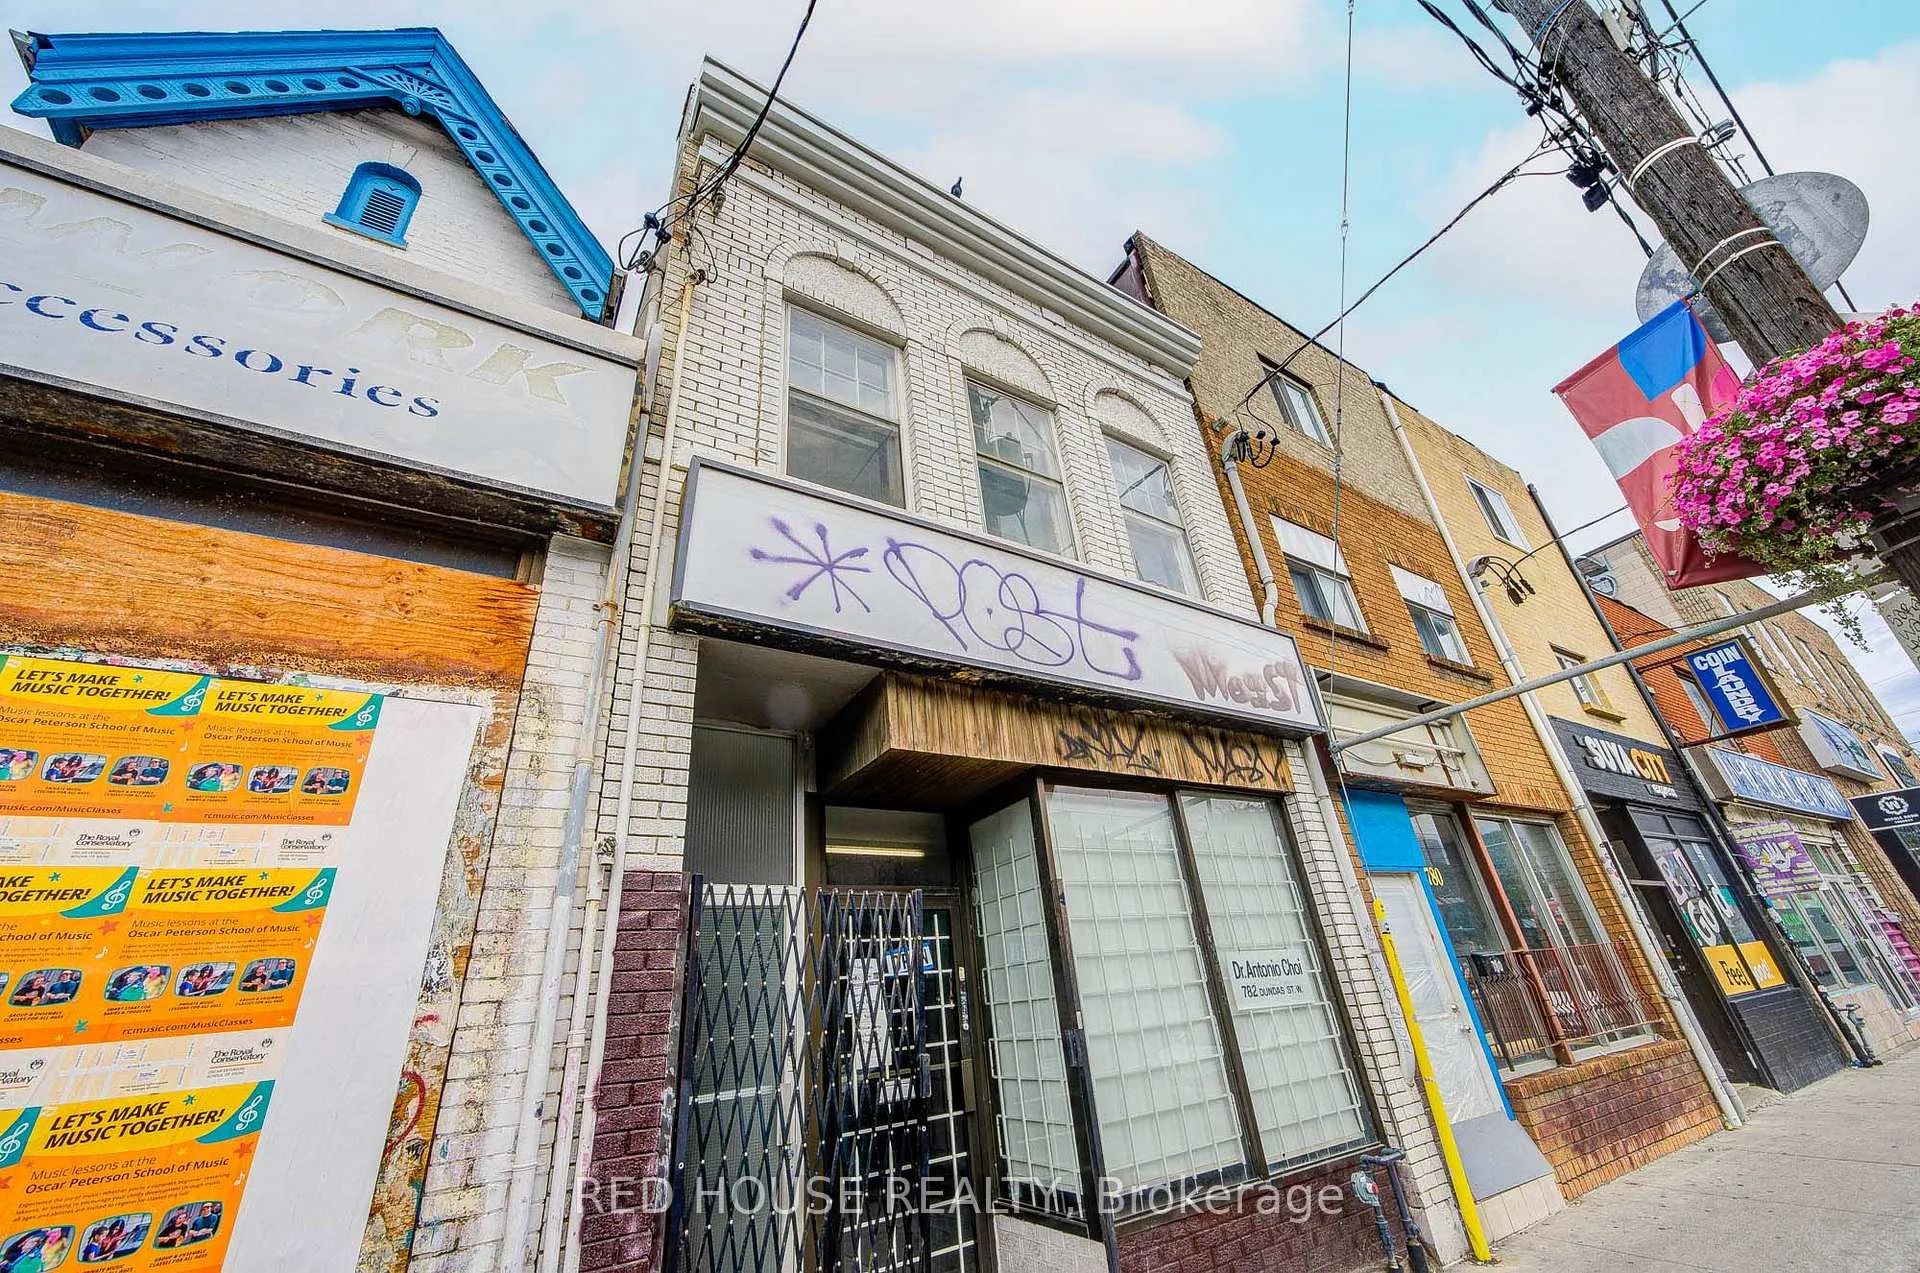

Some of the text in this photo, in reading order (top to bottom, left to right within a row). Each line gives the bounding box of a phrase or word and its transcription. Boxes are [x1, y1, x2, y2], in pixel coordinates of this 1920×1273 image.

[1693, 645, 1744, 671] COIN
[16, 669, 121, 686] LET'S MAKE
[10, 682, 172, 701] MUSIC TOGETHER!
[217, 691, 304, 704] LET'S MAKE
[0, 706, 32, 716] Music
[35, 709, 77, 720] lessons
[215, 702, 347, 718] MUSIC TOGETHER!
[33, 717, 88, 730] Peterson
[90, 721, 129, 733] School
[130, 724, 142, 733] of
[143, 726, 177, 736] Music
[206, 724, 235, 733] Music
[204, 732, 353, 748] Oscar Peterson School of Music
[75, 839, 133, 848] Conservatory
[79, 834, 121, 843] The Royal
[148, 875, 247, 890] LET'S MAKE
[1424, 866, 1444, 887] 780
[142, 886, 296, 904] MUSIC TOGETHER!
[128, 924, 300, 938] Oscar Peterson School of Music
[132, 918, 239, 929] Music lessons at the
[39, 931, 52, 941] of
[55, 931, 93, 941] Music
[1281, 958, 1304, 976] Choi
[1719, 960, 1751, 987] Feel
[1241, 984, 1259, 998] 782
[1259, 985, 1286, 997] DUNDAS
[122, 1017, 254, 1036] rcmusic.com/MusicClasses
[210, 1053, 266, 1064] Conservatory
[213, 1047, 254, 1059] The Royal
[50, 1101, 170, 1132] LET'S MAKE
[44, 1109, 226, 1149] MUSIC TOGETHER!
[25, 1157, 230, 1195] Oscar Peterson School of Music
[31, 1155, 158, 1182] Music lessons at the
